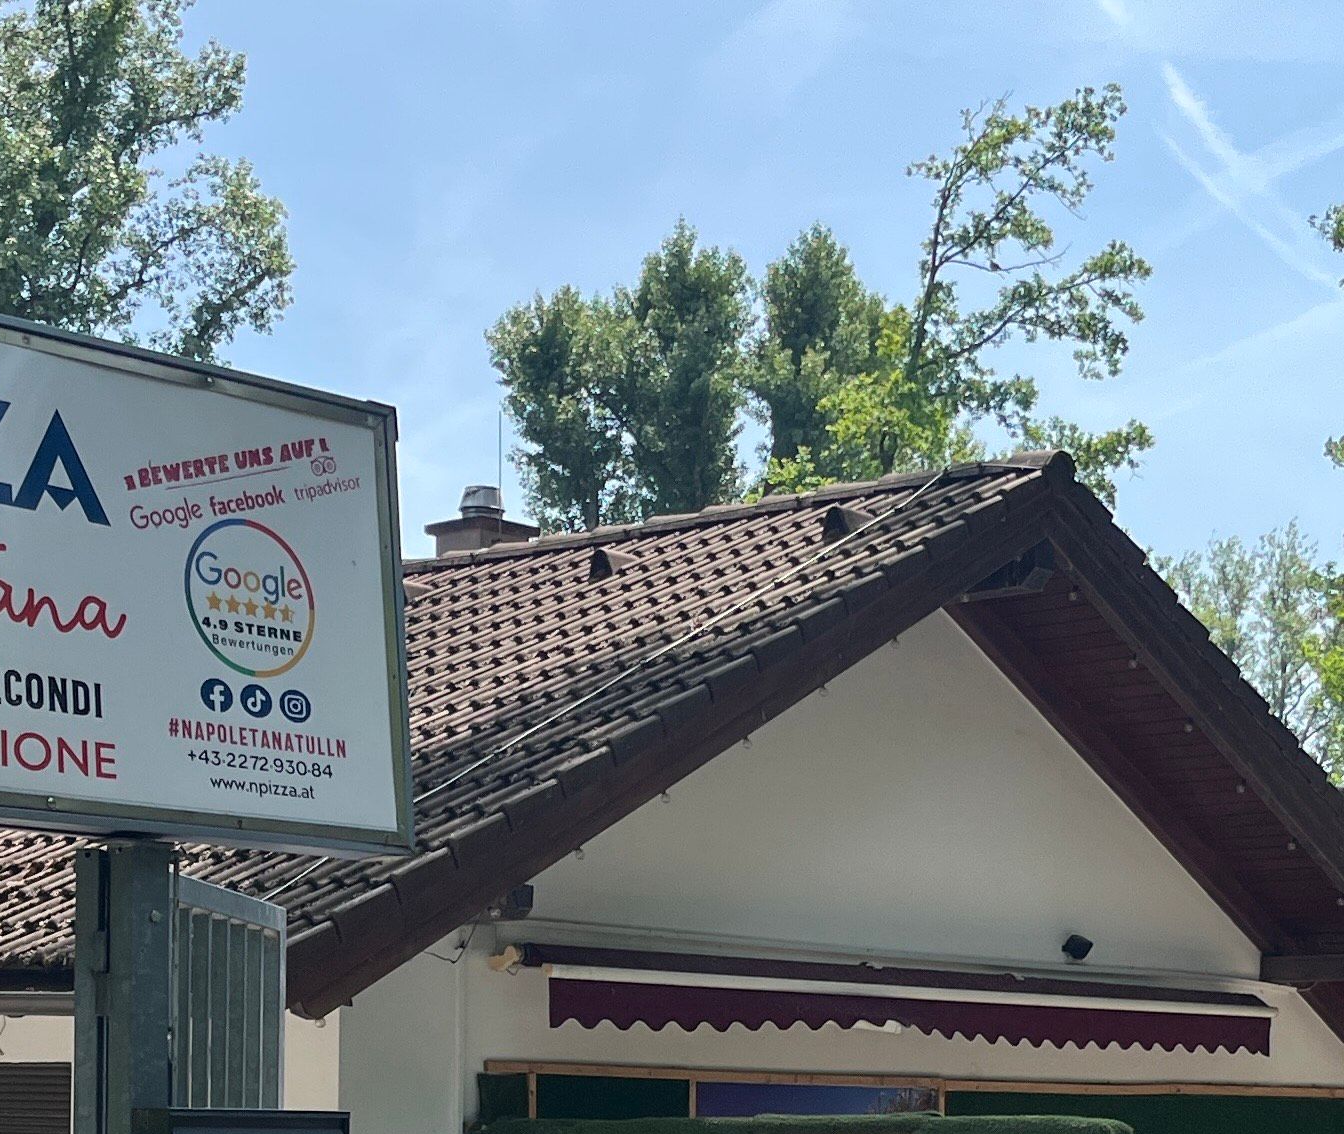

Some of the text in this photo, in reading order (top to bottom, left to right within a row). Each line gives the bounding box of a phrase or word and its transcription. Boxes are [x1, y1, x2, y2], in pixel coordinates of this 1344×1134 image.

[138, 454, 229, 488] BEWERTE
[234, 447, 274, 469] UNS
[280, 438, 315, 462] AUF
[130, 477, 361, 529] Google facebook tripadvisor
[195, 551, 303, 604] Google
[202, 616, 303, 642] 4.9 STERNE
[212, 633, 295, 656] Bewertungen
[168, 718, 347, 758] #NAPOLETANATULLN
[210, 776, 316, 800] www.npizza.at
